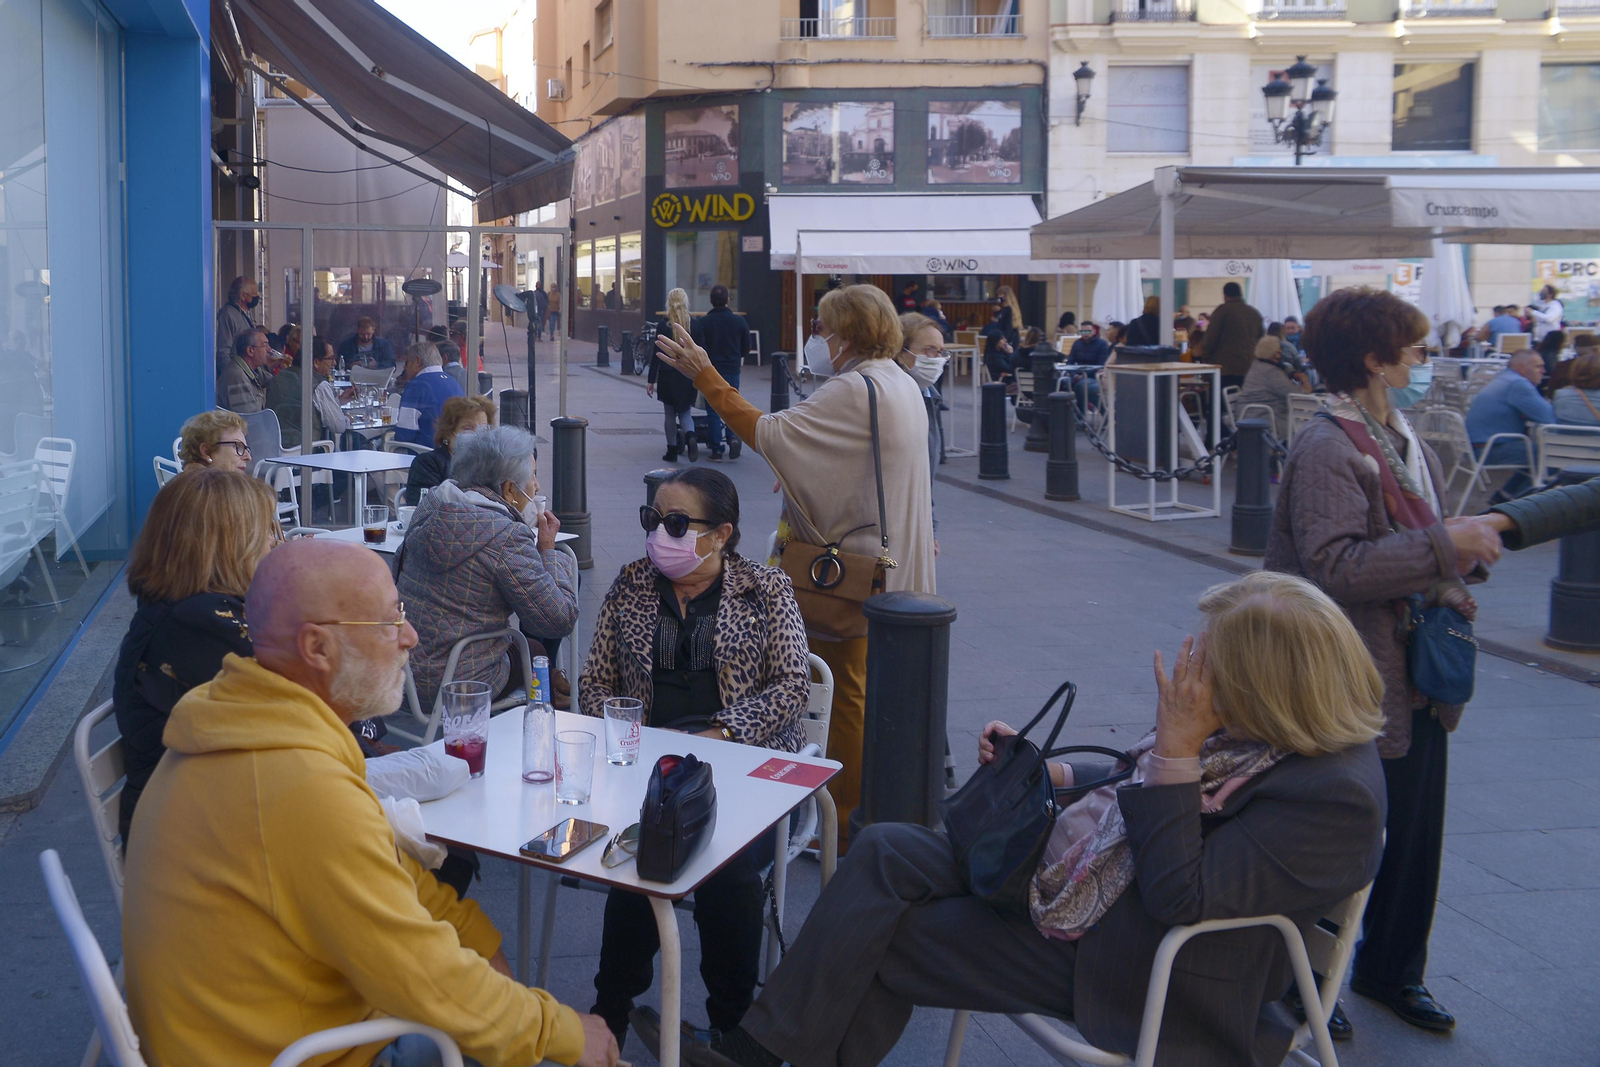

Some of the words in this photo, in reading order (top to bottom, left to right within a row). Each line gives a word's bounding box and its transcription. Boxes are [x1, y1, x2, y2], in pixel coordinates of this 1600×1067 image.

[711, 172, 731, 181] WIND
[863, 169, 887, 179] WIND
[987, 168, 1012, 178] WIND
[683, 193, 755, 223] WIND
[1426, 202, 1499, 218] Cruzcampo
[943, 259, 979, 271] WIND
[769, 763, 798, 779] Cruzcampo
